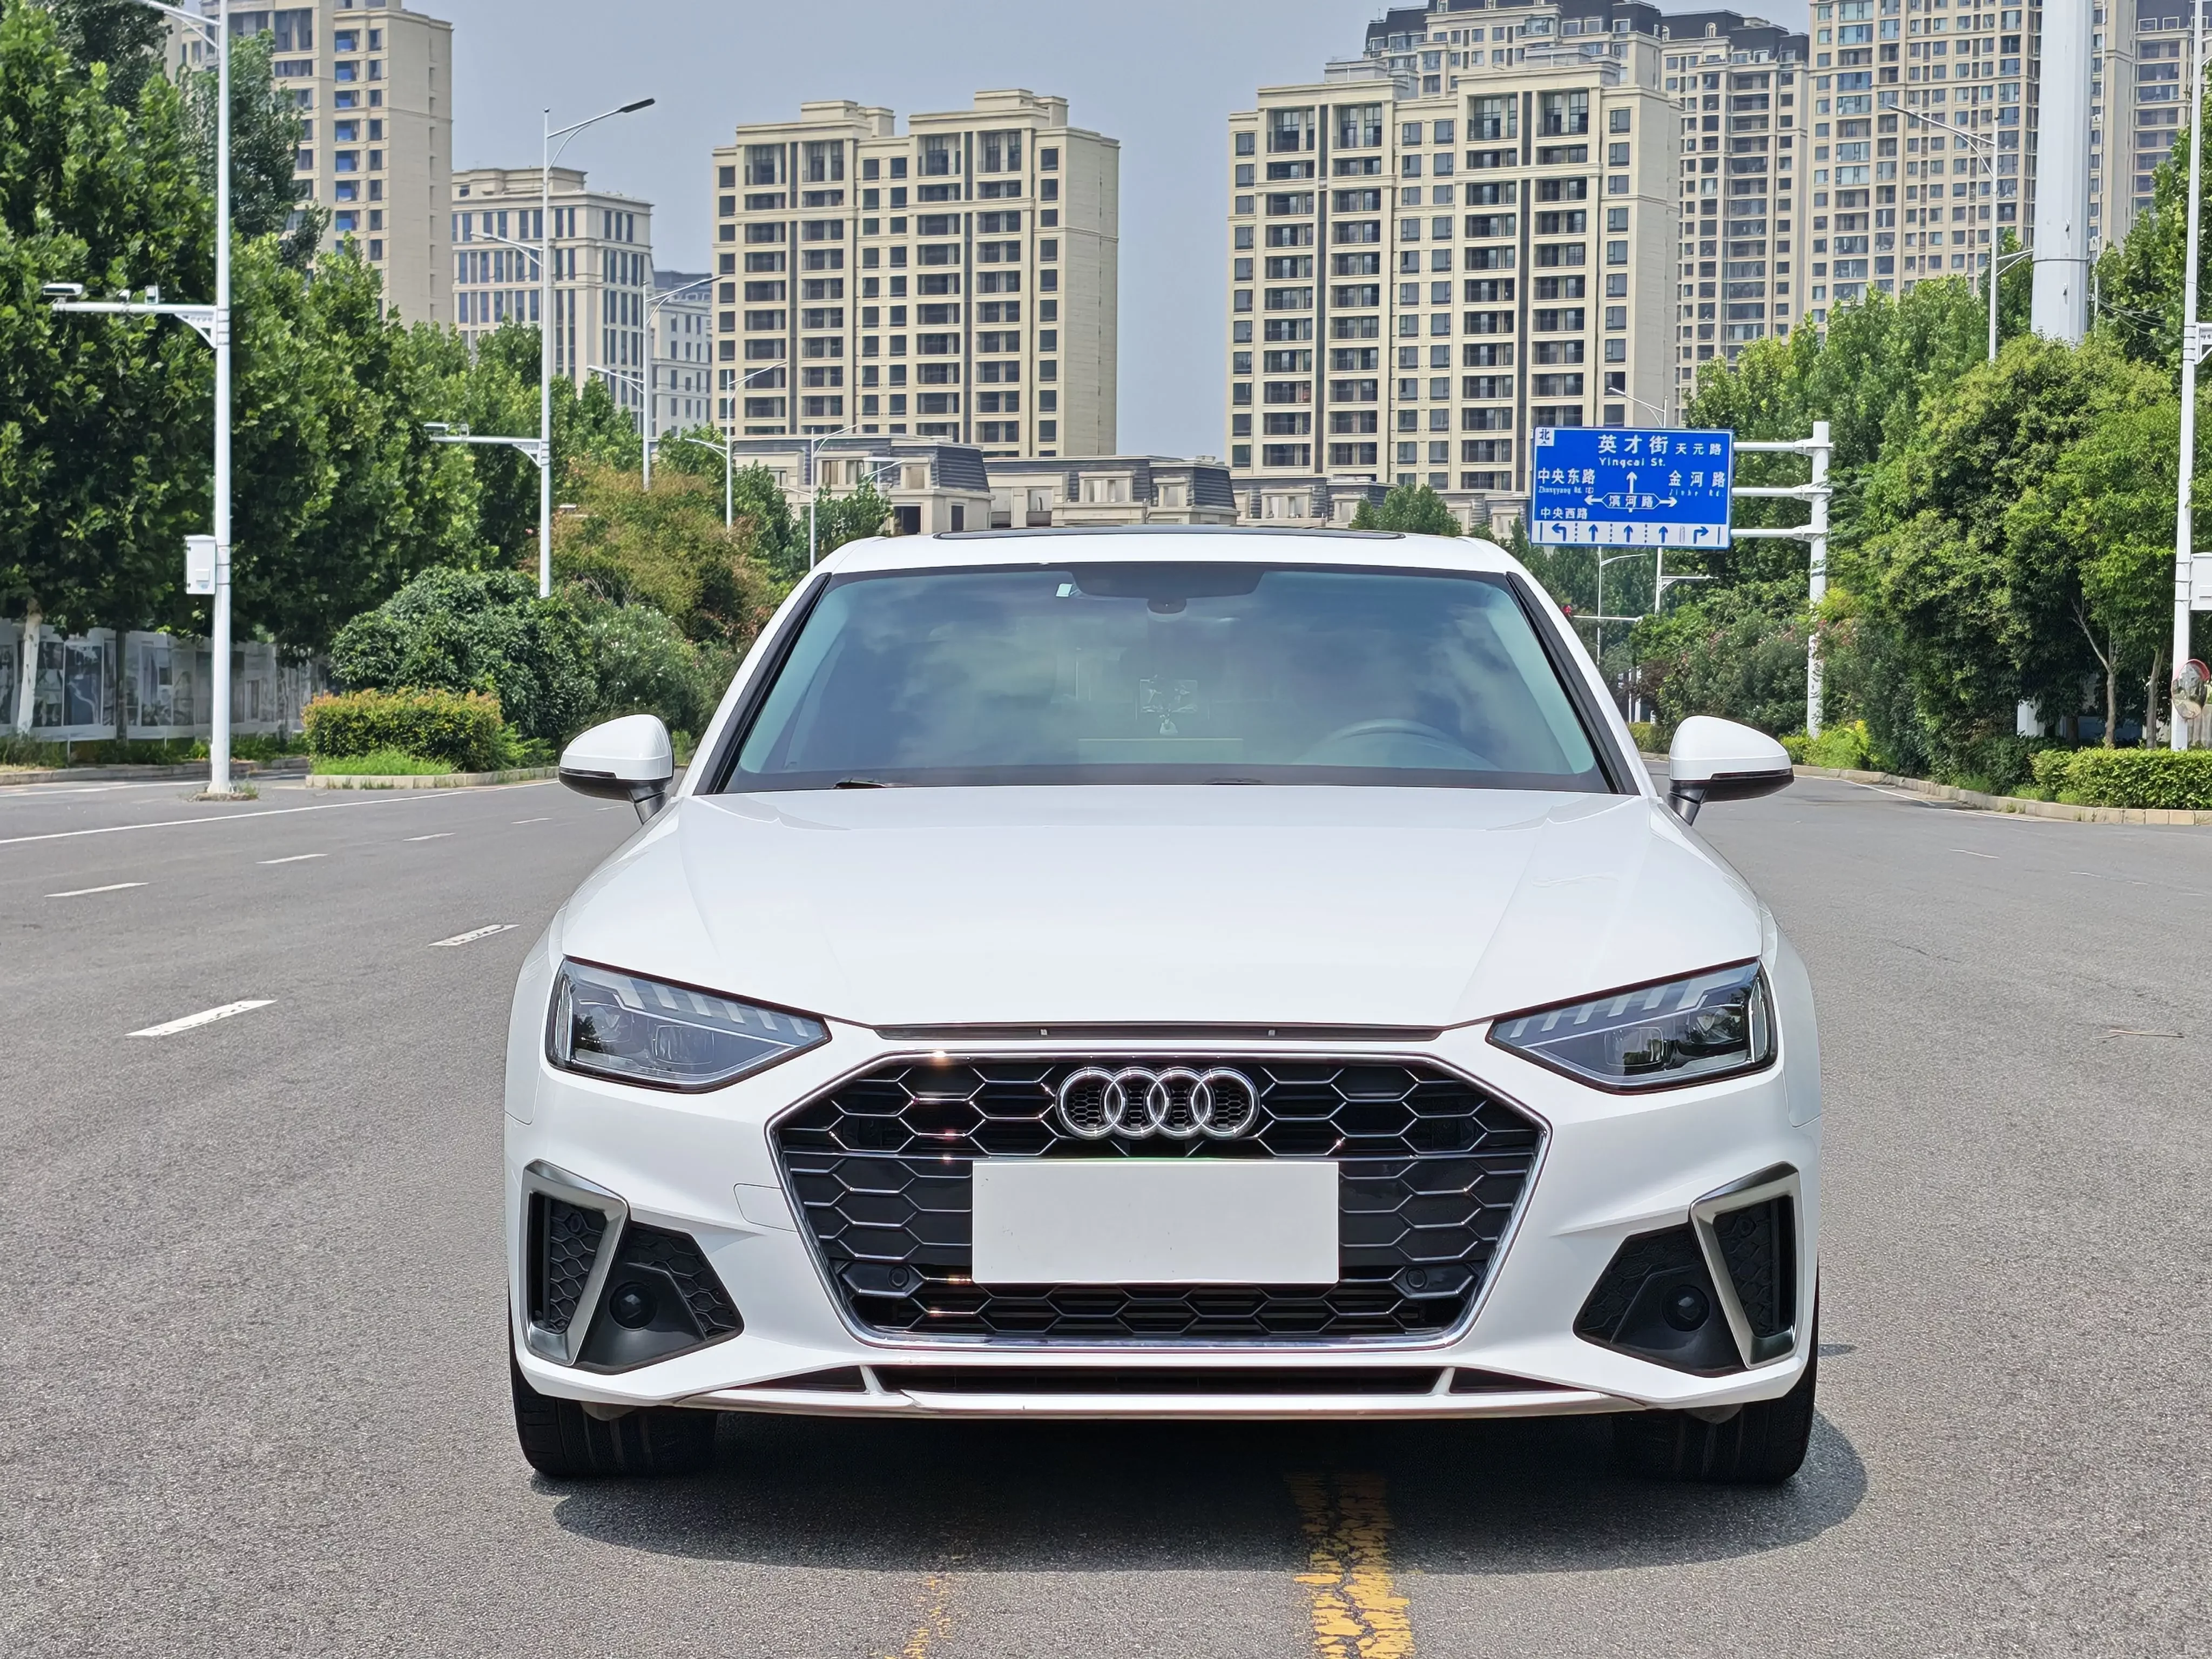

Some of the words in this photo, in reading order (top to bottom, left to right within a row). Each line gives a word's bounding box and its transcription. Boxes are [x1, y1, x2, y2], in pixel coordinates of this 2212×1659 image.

[1539, 428, 1550, 440] 北
[1598, 434, 1668, 454] 英才街
[1675, 443, 1721, 455] 天元路
[1599, 457, 1644, 469] Yingcai
[1651, 457, 1666, 467] St.
[1537, 467, 1595, 485] 中央东路
[1668, 469, 1725, 488] 金河路
[1541, 507, 1588, 520] 中央西路
